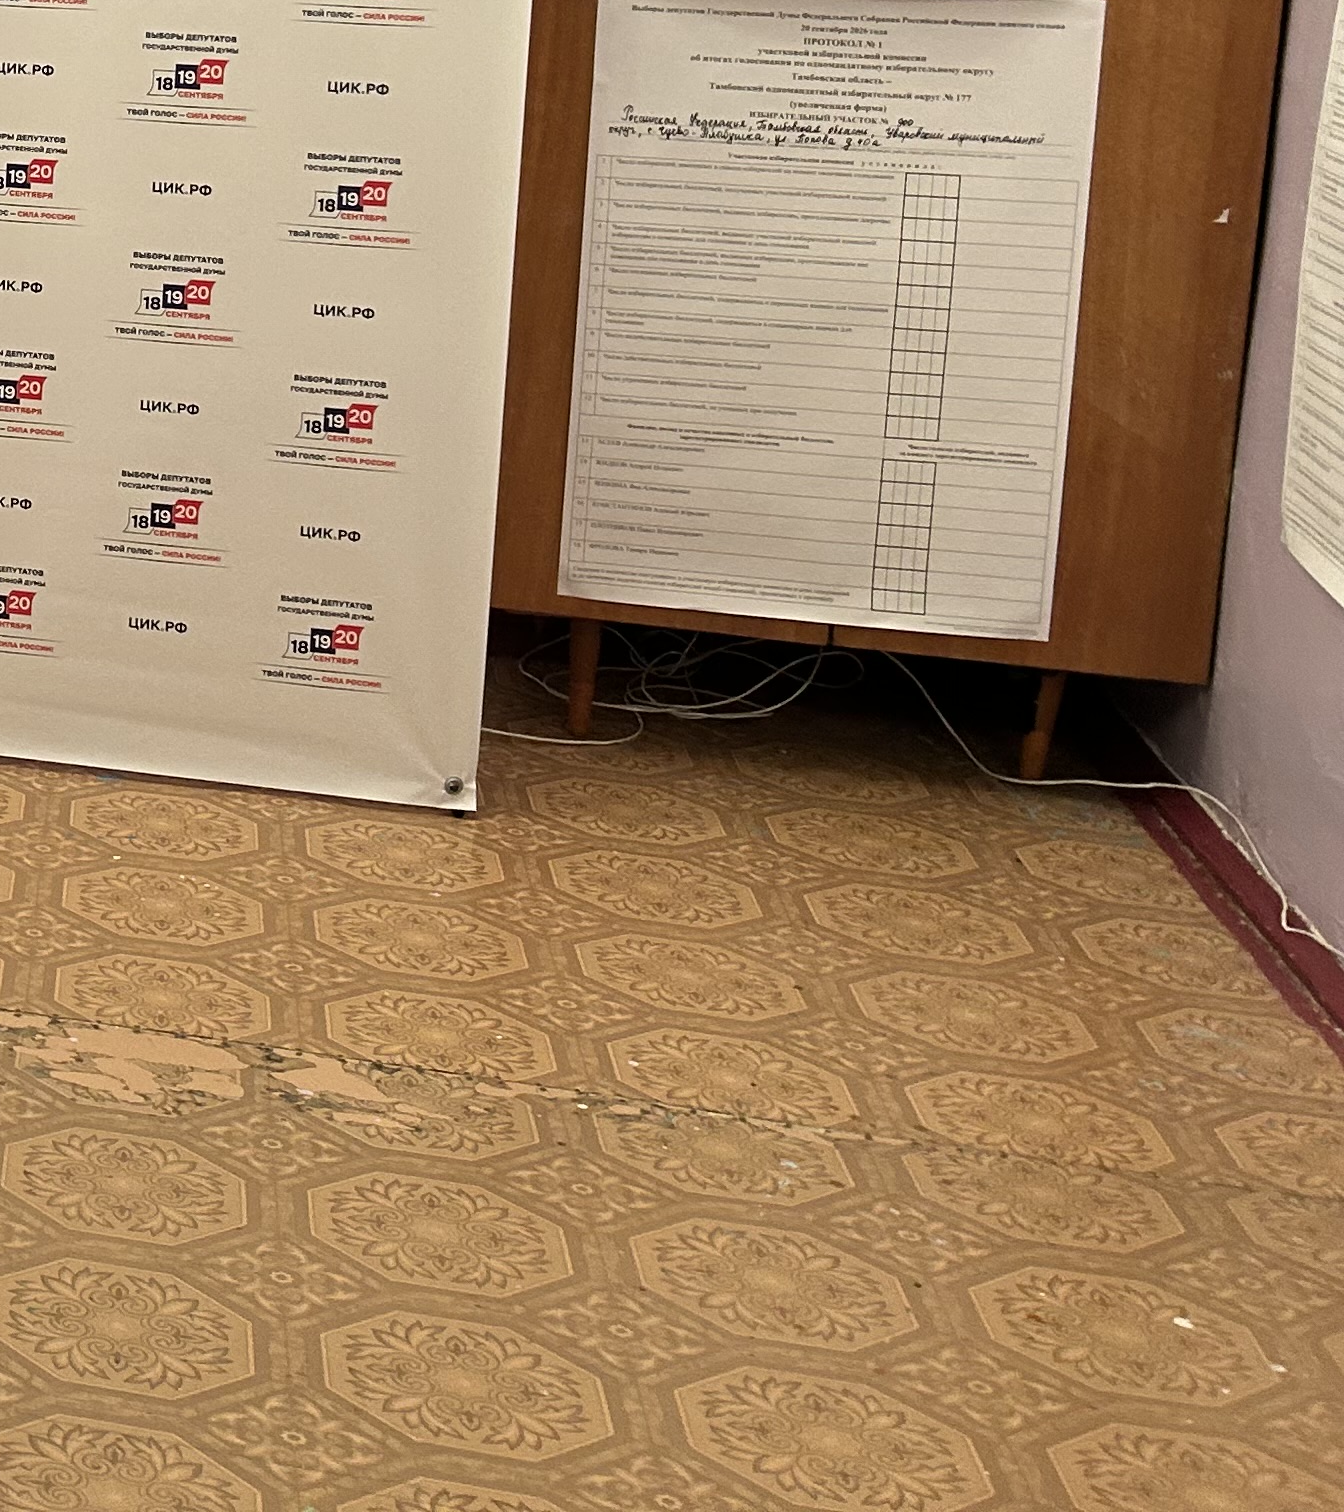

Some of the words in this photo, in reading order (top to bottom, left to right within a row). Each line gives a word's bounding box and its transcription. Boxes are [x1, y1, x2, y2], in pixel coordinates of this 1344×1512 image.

[803, 37, 863, 48] ПРОТОКОЛ
[155, 77, 173, 91] 18
[177, 70, 196, 85] 19
[199, 65, 223, 79] 20
[327, 80, 390, 96] ЦИК.РФ
[8, 169, 27, 184] 19
[30, 164, 52, 179] 20
[152, 181, 213, 197] ЦИК.РФ
[317, 198, 336, 213] 18
[339, 192, 359, 207] 19
[362, 186, 386, 202] 20
[143, 296, 161, 310] 18
[164, 290, 183, 305] 19
[187, 285, 210, 300] 20
[313, 303, 375, 320] ЦИК.РФ
[19, 380, 41, 395] 20
[139, 399, 200, 415] ЦИК.РФ
[304, 419, 322, 434] 18
[326, 414, 345, 429] 19
[348, 409, 372, 425] 20
[131, 514, 149, 529] 18
[153, 509, 171, 524] 19
[175, 505, 197, 520] 20
[299, 525, 361, 543] ЦИК.РФ
[8, 595, 31, 611] 20
[280, 594, 319, 605] ВЫБОРЫ
[320, 598, 373, 610] ДЕПУТАТОВ
[277, 606, 350, 619] ГОСУДАРСТВЕННОЙ
[351, 614, 375, 622] ДУМЫ
[128, 616, 188, 634] ЦИК.РФ
[291, 640, 309, 654] 18
[312, 634, 331, 650] 19
[335, 630, 358, 646] 20
[313, 655, 359, 666] СЕНТЯБРЯ
[262, 669, 284, 678] ТВОЙ
[286, 672, 313, 681] ГОЛОС
[321, 676, 344, 685] СИЛА
